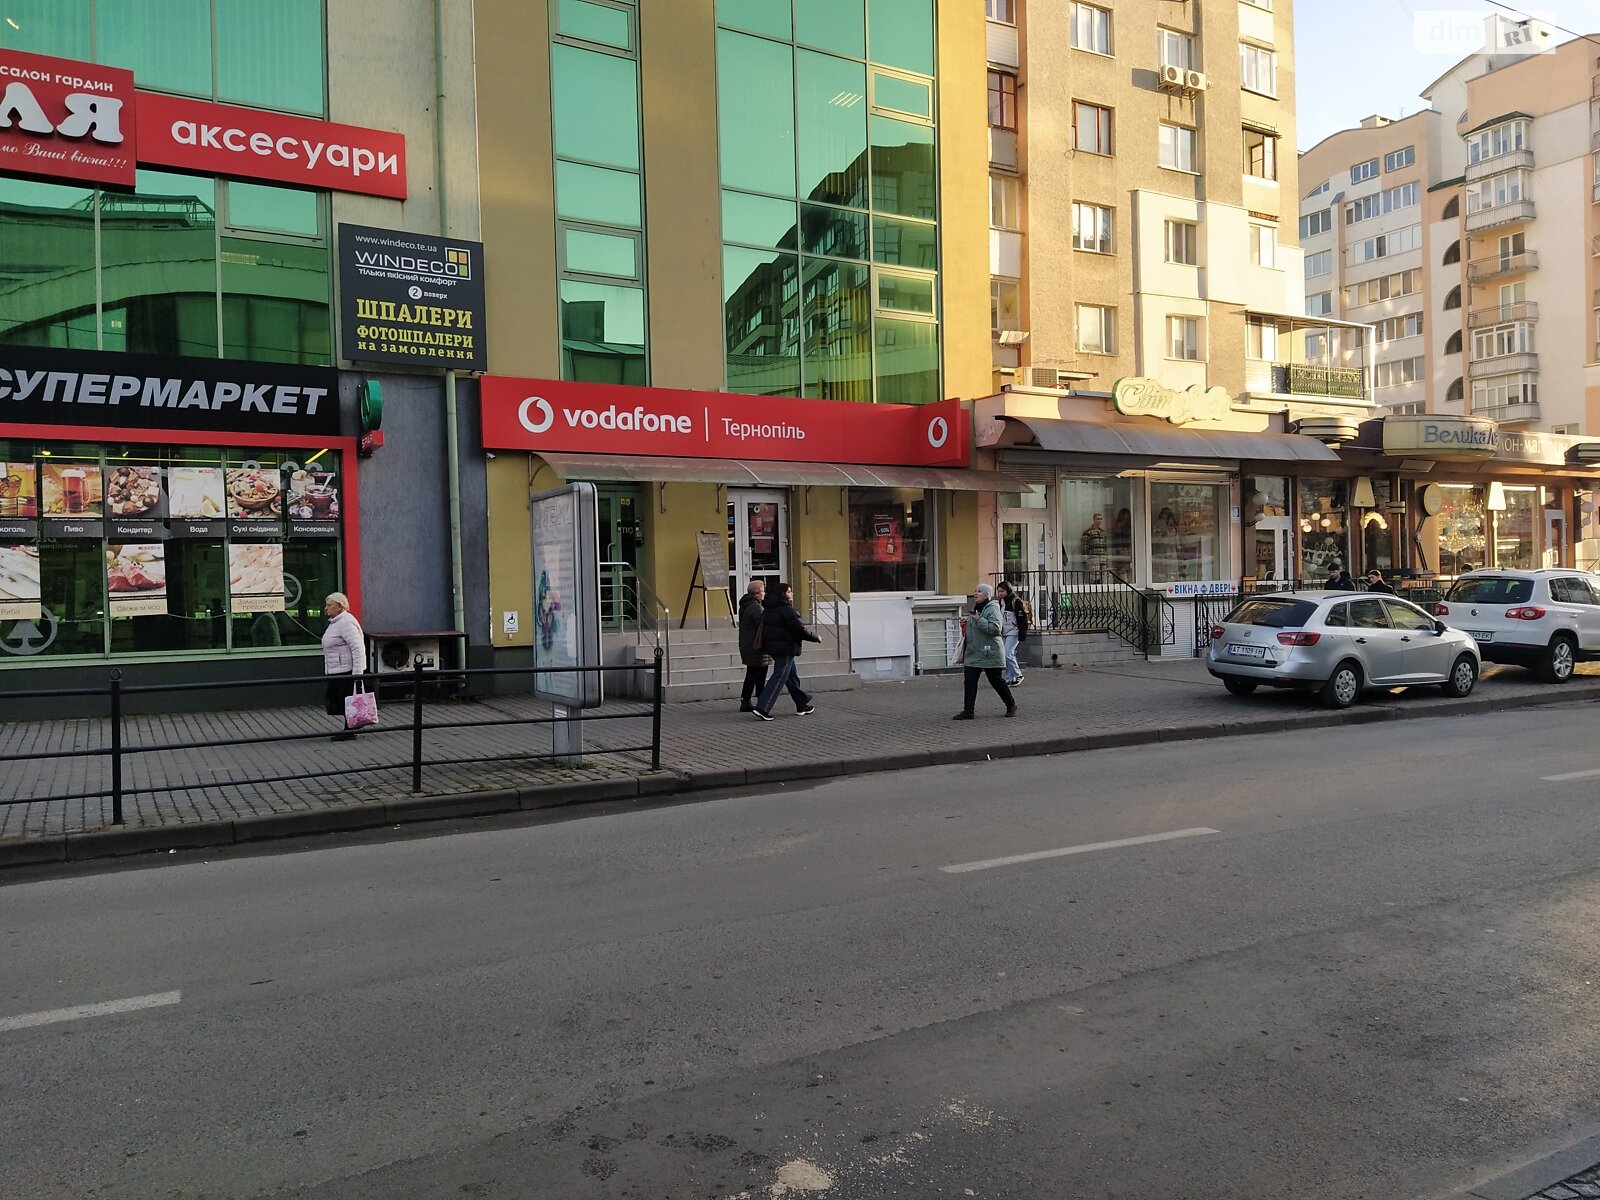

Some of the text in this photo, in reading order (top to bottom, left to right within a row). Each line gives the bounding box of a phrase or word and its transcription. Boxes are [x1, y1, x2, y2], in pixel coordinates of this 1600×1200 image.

[0, 65, 113, 92] салон гардин
[23, 142, 67, 160] Ваші
[70, 150, 127, 169] вікна!!!
[171, 120, 398, 176] аксесуари
[355, 234, 437, 252] www.windeco.te.ua
[355, 250, 458, 275] WINDECO
[356, 298, 473, 329] ШПАЛЕРИ
[356, 325, 473, 348] ФОТОШПАЛЕРИ
[358, 341, 474, 360] на замовлення
[563, 404, 692, 434] vodafone
[721, 417, 806, 441] Тернопіль
[1424, 424, 1486, 444] Велика
[64, 525, 84, 533] Пиво
[117, 525, 153, 536] Кондитер
[190, 526, 208, 535] Вода
[232, 526, 279, 535] Сухі сніданки
[293, 525, 335, 534] Консервація
[1174, 583, 1231, 594] ВІКНА ДВЕРІ
